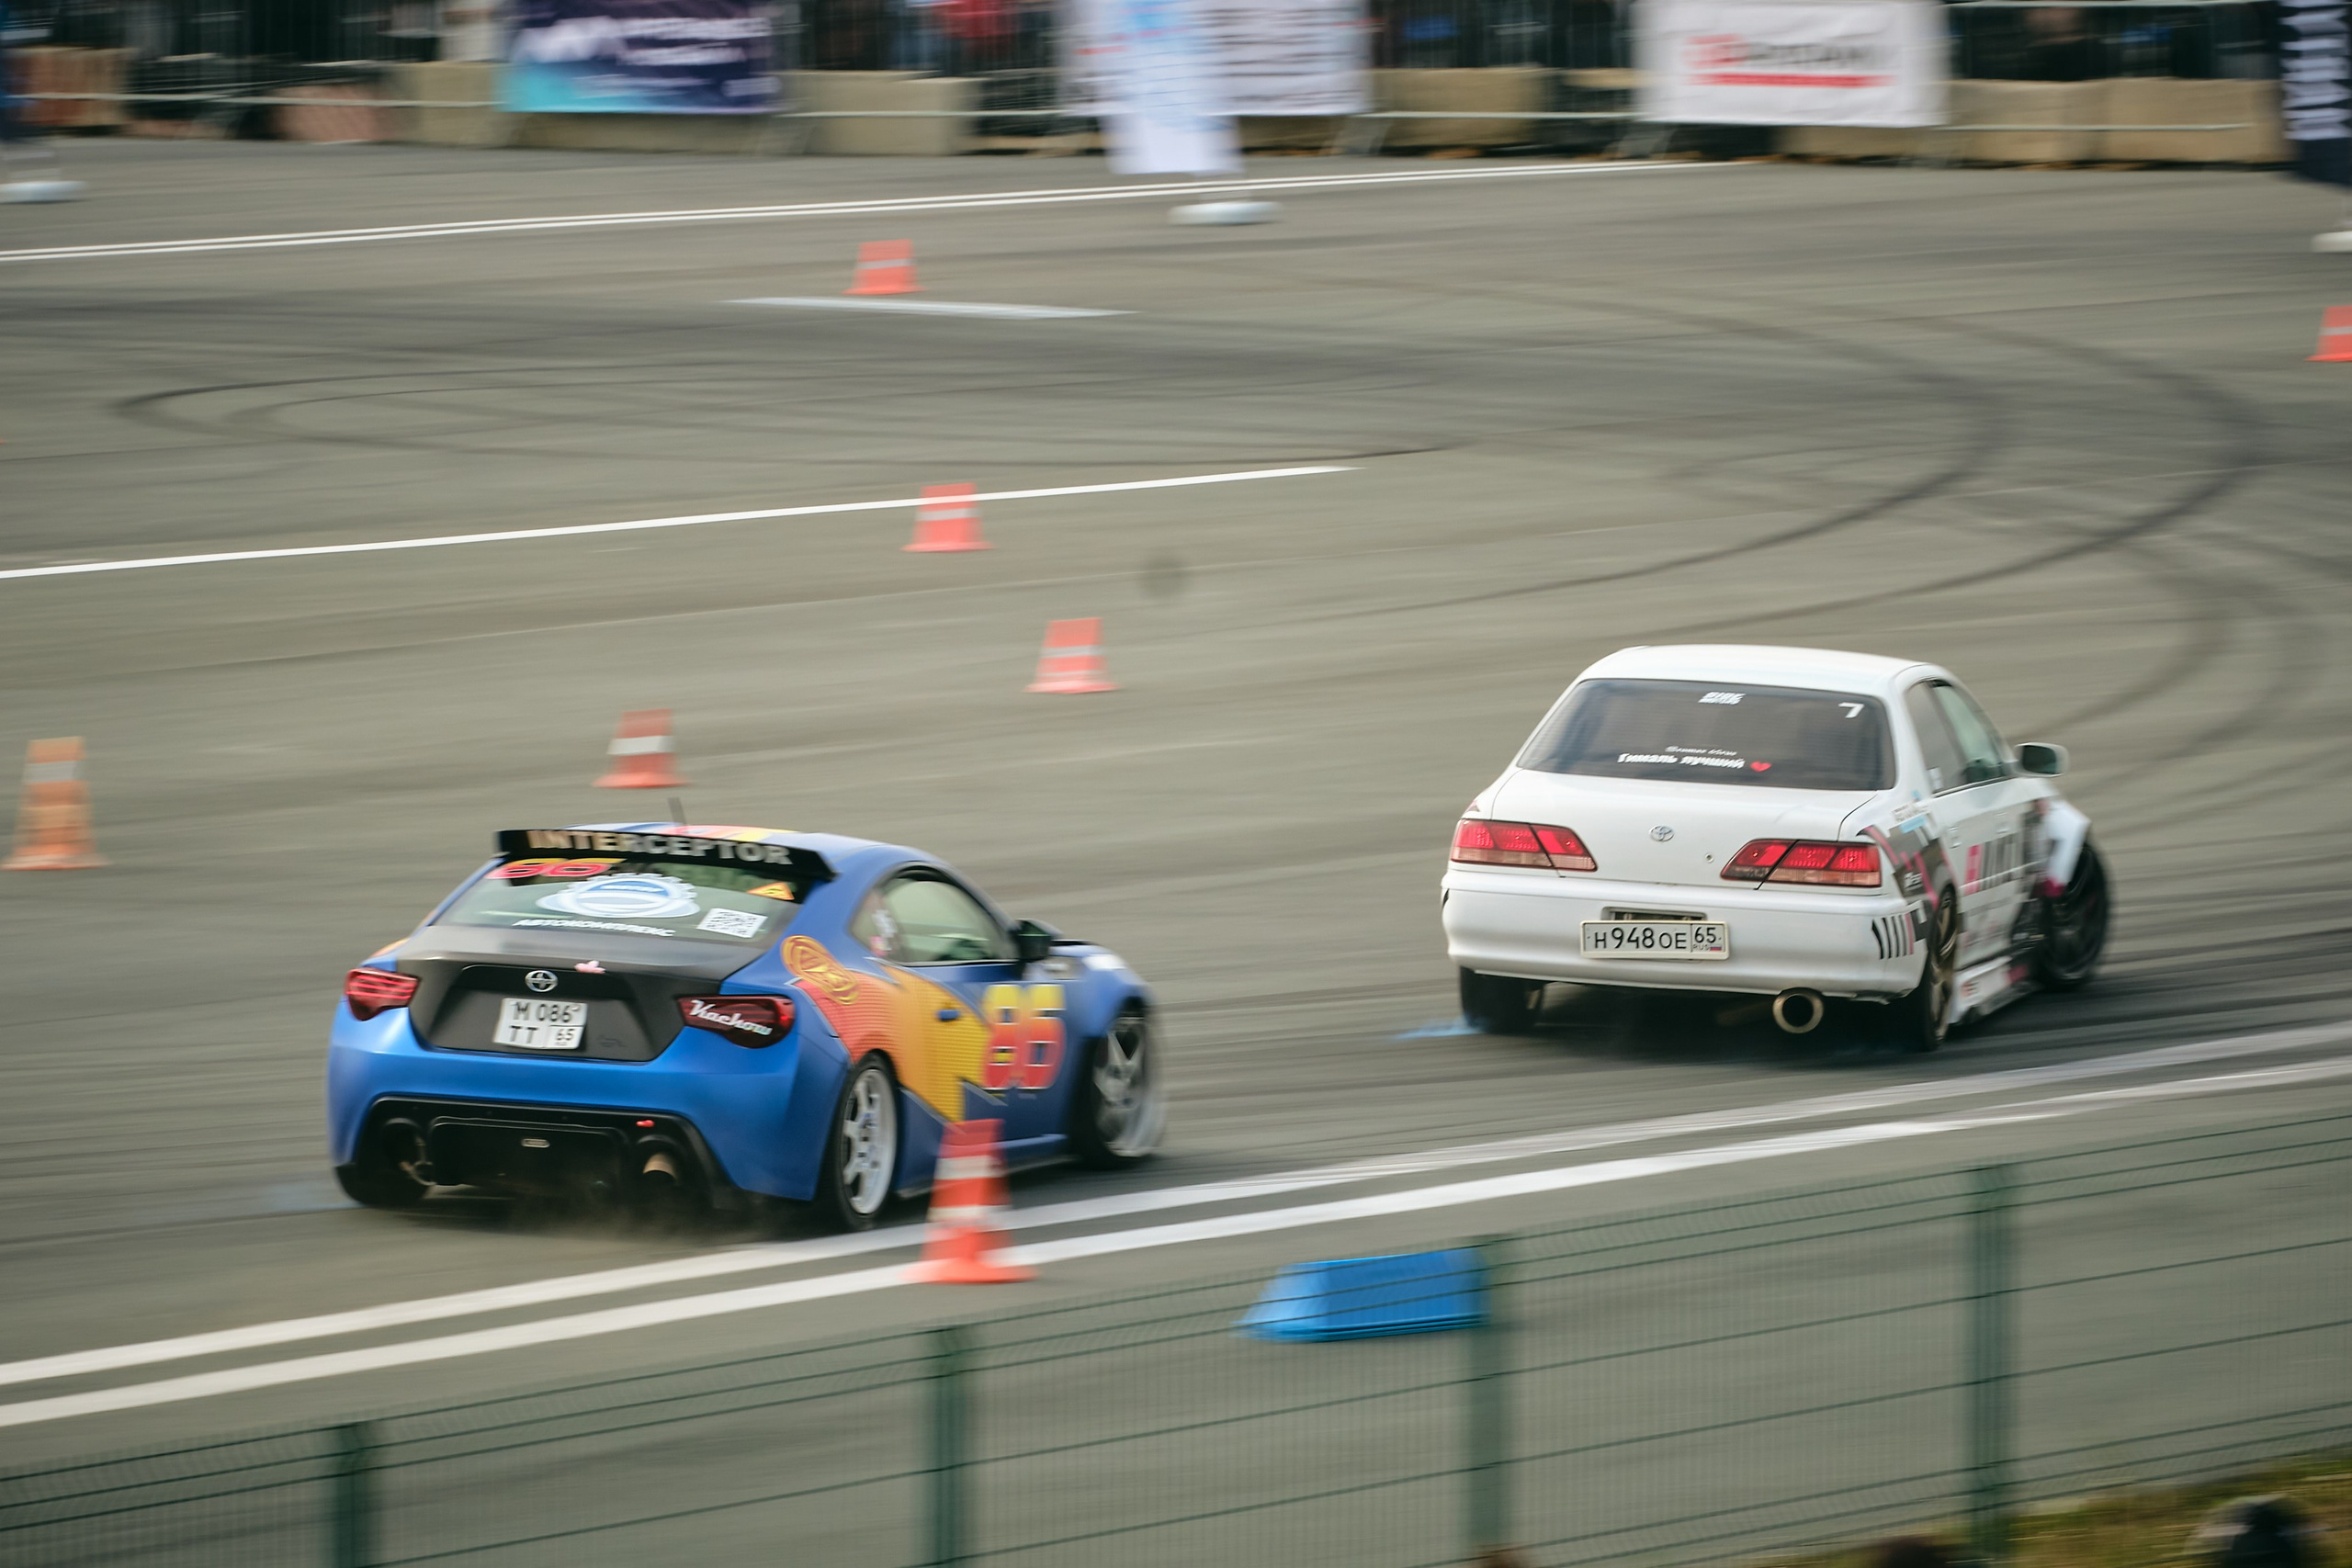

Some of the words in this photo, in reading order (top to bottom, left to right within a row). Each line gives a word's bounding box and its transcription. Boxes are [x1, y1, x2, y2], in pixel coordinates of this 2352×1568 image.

[1838, 702, 1865, 718] 7
[527, 829, 794, 865] INTERCEPTOR
[1694, 927, 1717, 943] 65
[556, 1028, 576, 1042] 65
